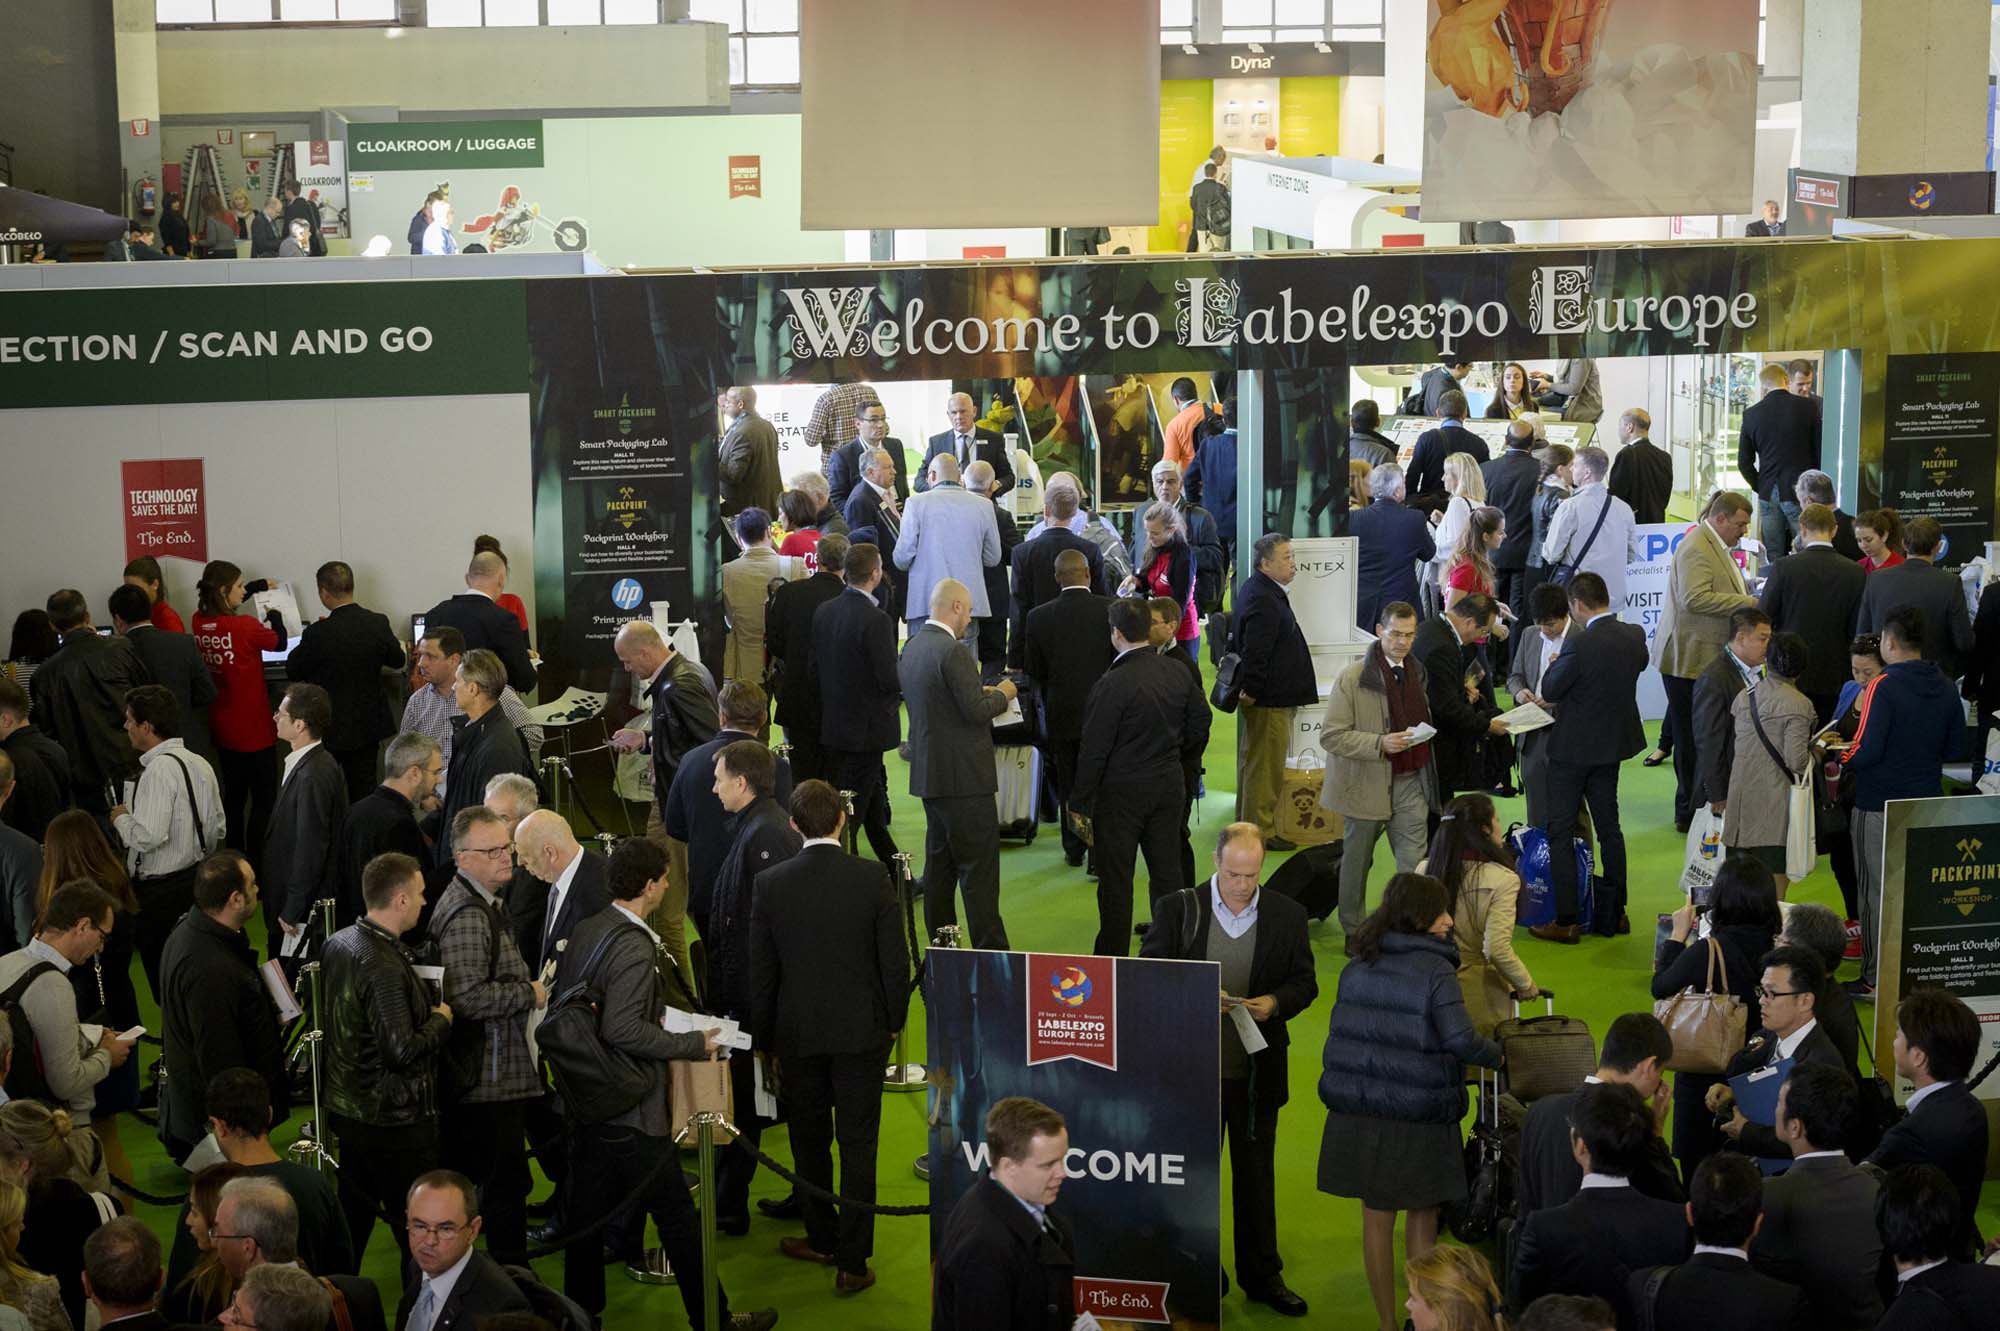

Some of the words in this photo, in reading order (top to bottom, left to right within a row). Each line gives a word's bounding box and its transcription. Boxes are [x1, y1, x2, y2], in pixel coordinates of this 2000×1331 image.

[1231, 55, 1274, 73] Dyna
[356, 139, 451, 153] CLOAKROOM
[455, 138, 463, 152] /
[467, 137, 536, 151] LUGGAGE
[301, 176, 342, 186] CLOAKROOM
[780, 286, 1080, 359] Welcome
[1100, 304, 1160, 350] to
[1175, 277, 1509, 356] Labelexpo
[1529, 265, 1758, 347] Europe
[0, 334, 137, 363] ECTION
[149, 330, 169, 364] /
[179, 330, 278, 359] SCAN
[290, 327, 368, 356] AND
[380, 325, 433, 353] GO
[593, 409, 616, 418] SMART
[618, 407, 656, 417] PACKAGING
[1902, 403, 1924, 412] Smart
[1926, 401, 1963, 412] Packaging
[1965, 400, 1980, 409] Lab
[580, 440, 605, 450] Smart
[607, 438, 650, 450] Packaging
[651, 437, 668, 447] Lab
[130, 488, 198, 504] TECHNOLOGY
[131, 504, 158, 517] SAVES
[160, 504, 176, 515] THE
[177, 503, 198, 514] DAY!
[606, 500, 647, 511] PACKPRINT
[136, 530, 163, 547] The
[166, 530, 195, 544] End.
[583, 533, 624, 544] Packprint
[624, 530, 669, 542] Workshop
[1295, 561, 1345, 571] NTEX
[616, 578, 639, 609] hp
[1625, 592, 1663, 607] VISIT
[592, 615, 615, 624] Print
[616, 616, 636, 625] your
[195, 632, 232, 649] need
[1943, 894, 1993, 905] WORKSHOP
[1912, 942, 1960, 955] Packprint
[1038, 1019, 1105, 1032] LABELEXPO
[1038, 1030, 1076, 1039] EUROPE
[1079, 1032, 1105, 1040] 2015
[961, 1141, 1185, 1185] WCOME
[1088, 1290, 1118, 1308] The
[1121, 1292, 1153, 1309] End.
